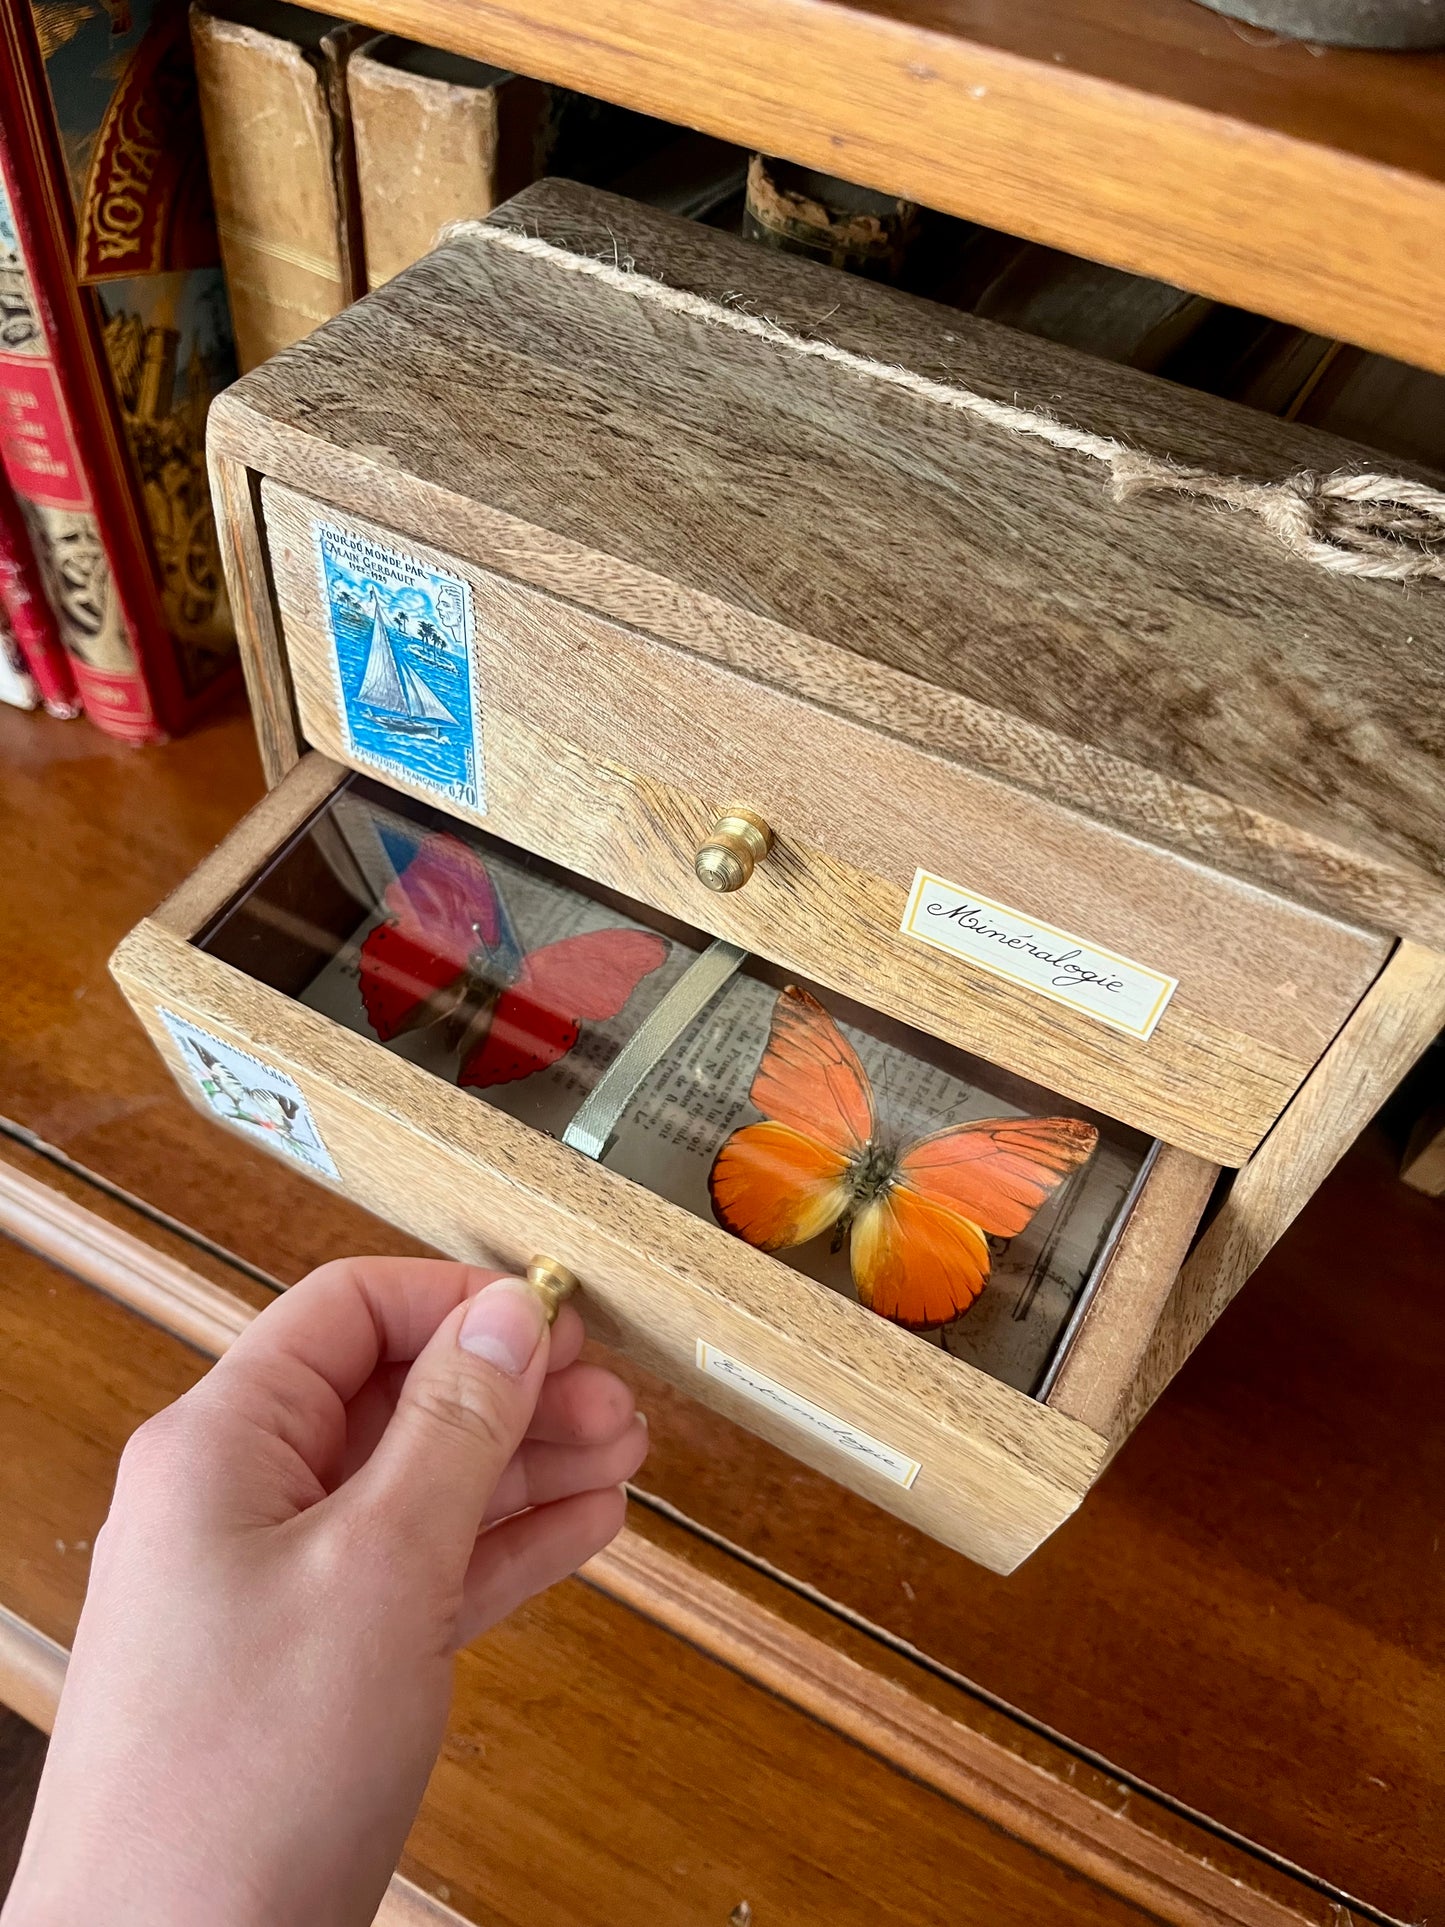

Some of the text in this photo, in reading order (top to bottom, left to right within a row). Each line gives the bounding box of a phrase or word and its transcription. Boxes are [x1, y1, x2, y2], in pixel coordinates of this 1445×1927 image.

[319, 527, 351, 548] TOUR
[365, 546, 403, 570] MONDE
[405, 563, 429, 579] PAR
[324, 540, 415, 586] ALAIN GERBAULT
[926, 900, 1124, 993] Minéralogie
[712, 1047, 742, 1081] Prusse
[669, 1101, 707, 1148] répondu
[713, 1359, 901, 1470] Entomologie
